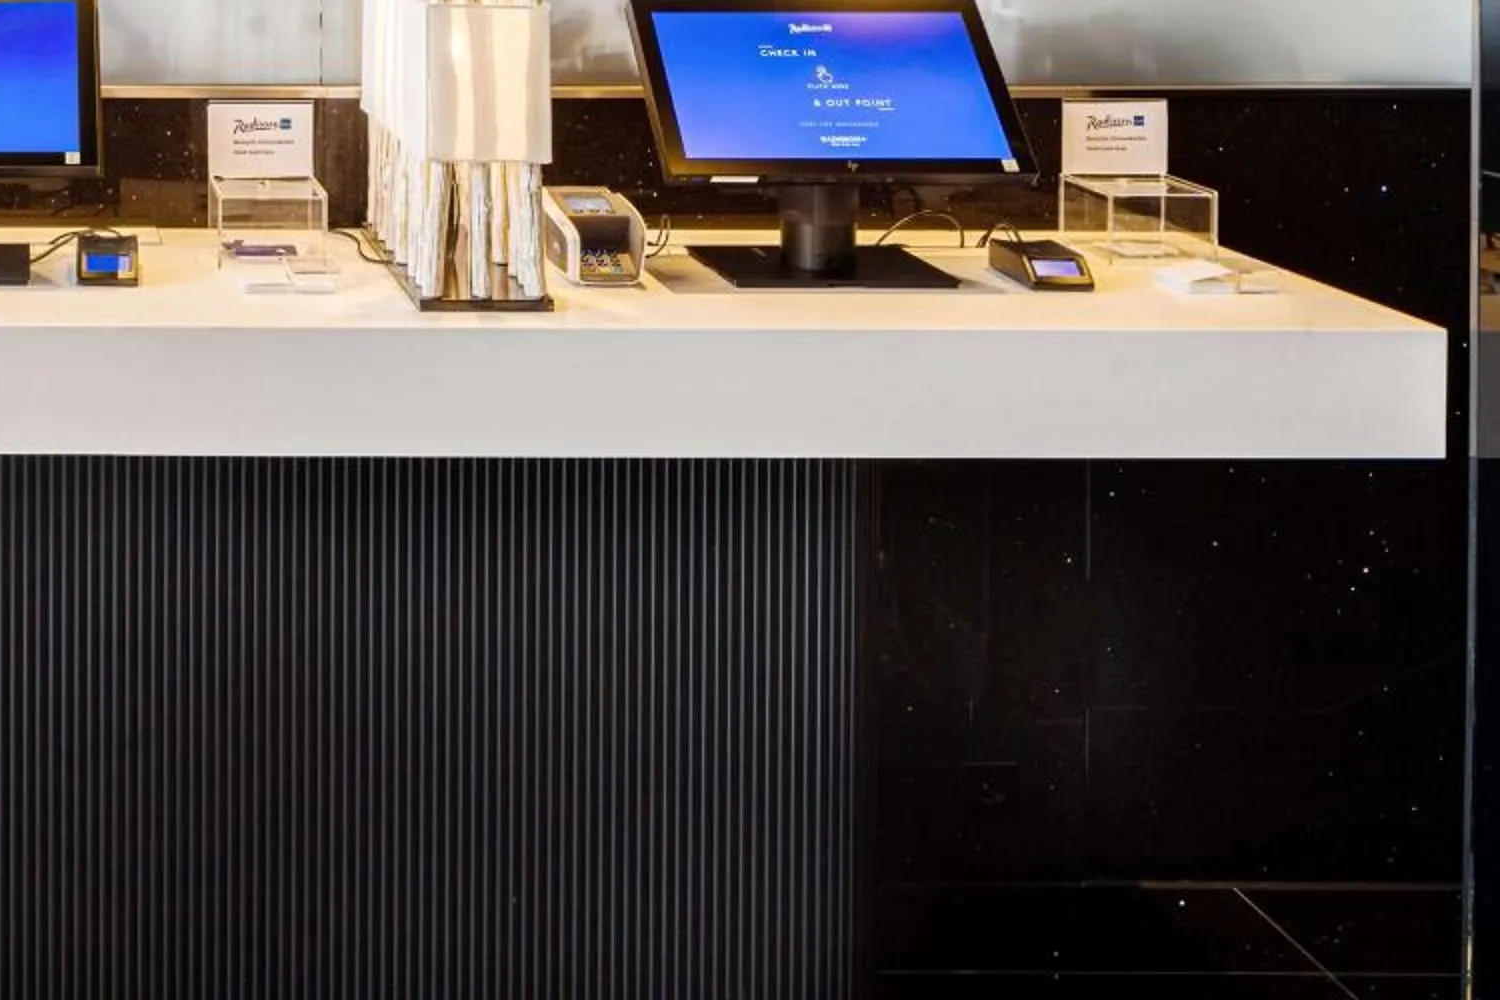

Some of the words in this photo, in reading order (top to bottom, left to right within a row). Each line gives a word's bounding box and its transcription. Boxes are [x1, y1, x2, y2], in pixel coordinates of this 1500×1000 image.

[759, 49, 800, 57] CHECK
[803, 49, 817, 57] IN
[825, 98, 850, 107] OUT
[855, 98, 891, 107] POINT
